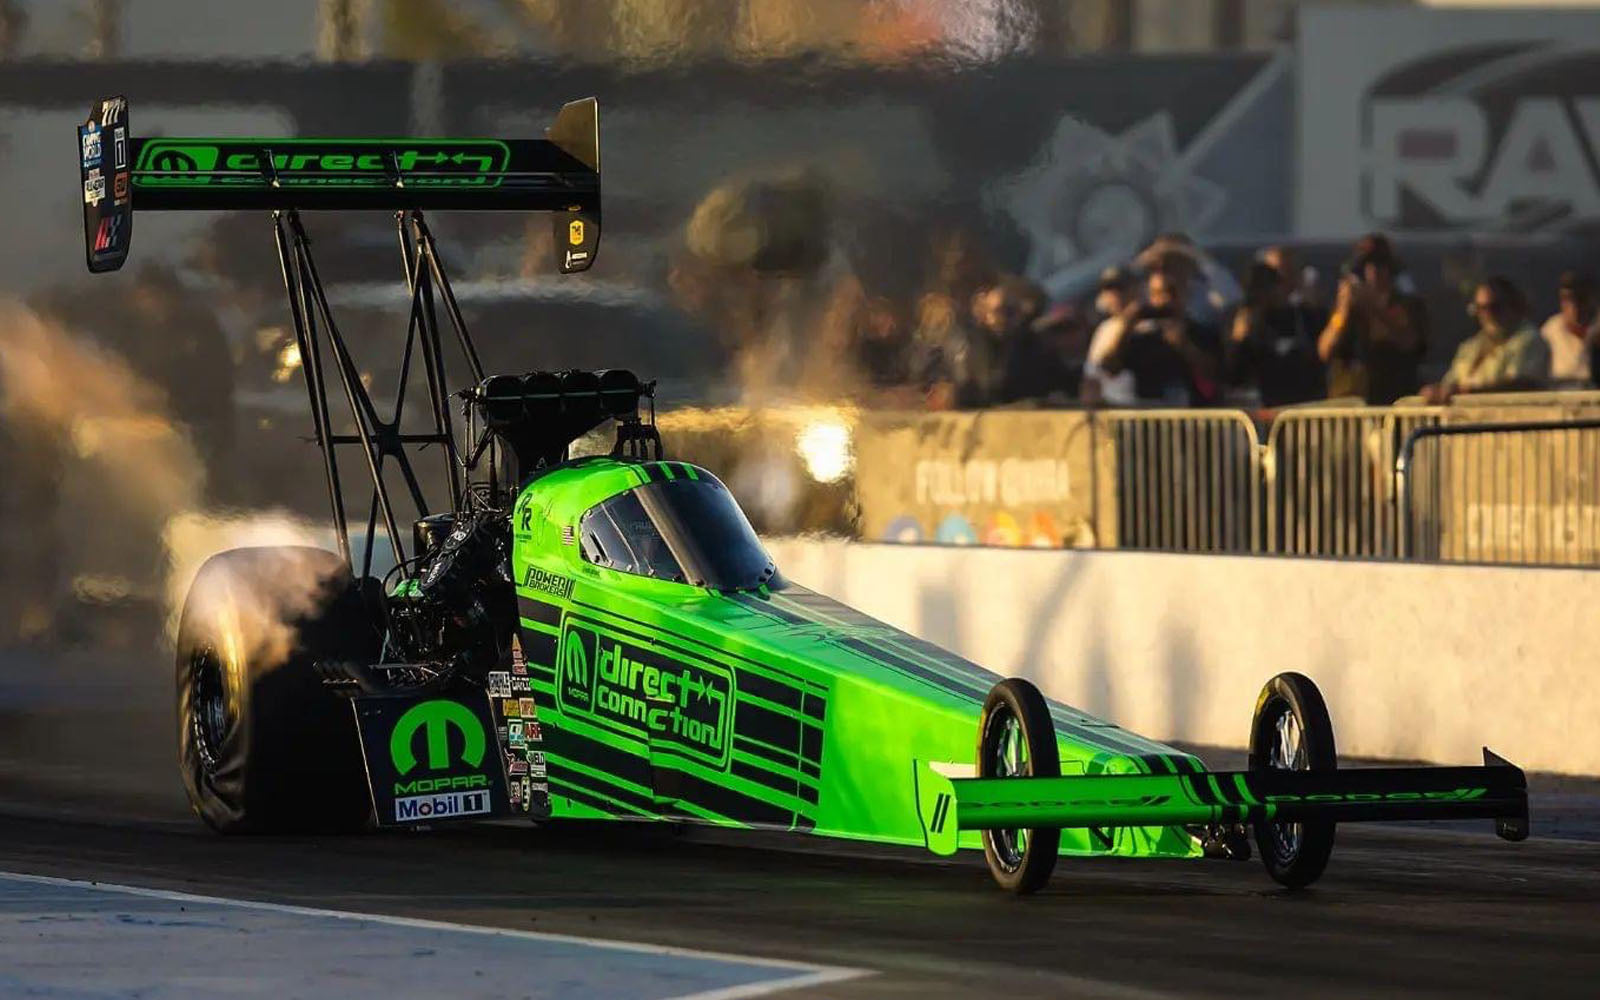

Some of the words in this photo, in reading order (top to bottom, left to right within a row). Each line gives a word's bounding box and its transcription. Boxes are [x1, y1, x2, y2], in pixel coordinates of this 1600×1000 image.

[1371, 98, 1600, 224] RA
[527, 568, 566, 589] POWER
[528, 580, 566, 598] BROKERS
[600, 644, 691, 708] direct
[395, 774, 487, 795] MOPAR
[398, 796, 459, 818] Mobil
